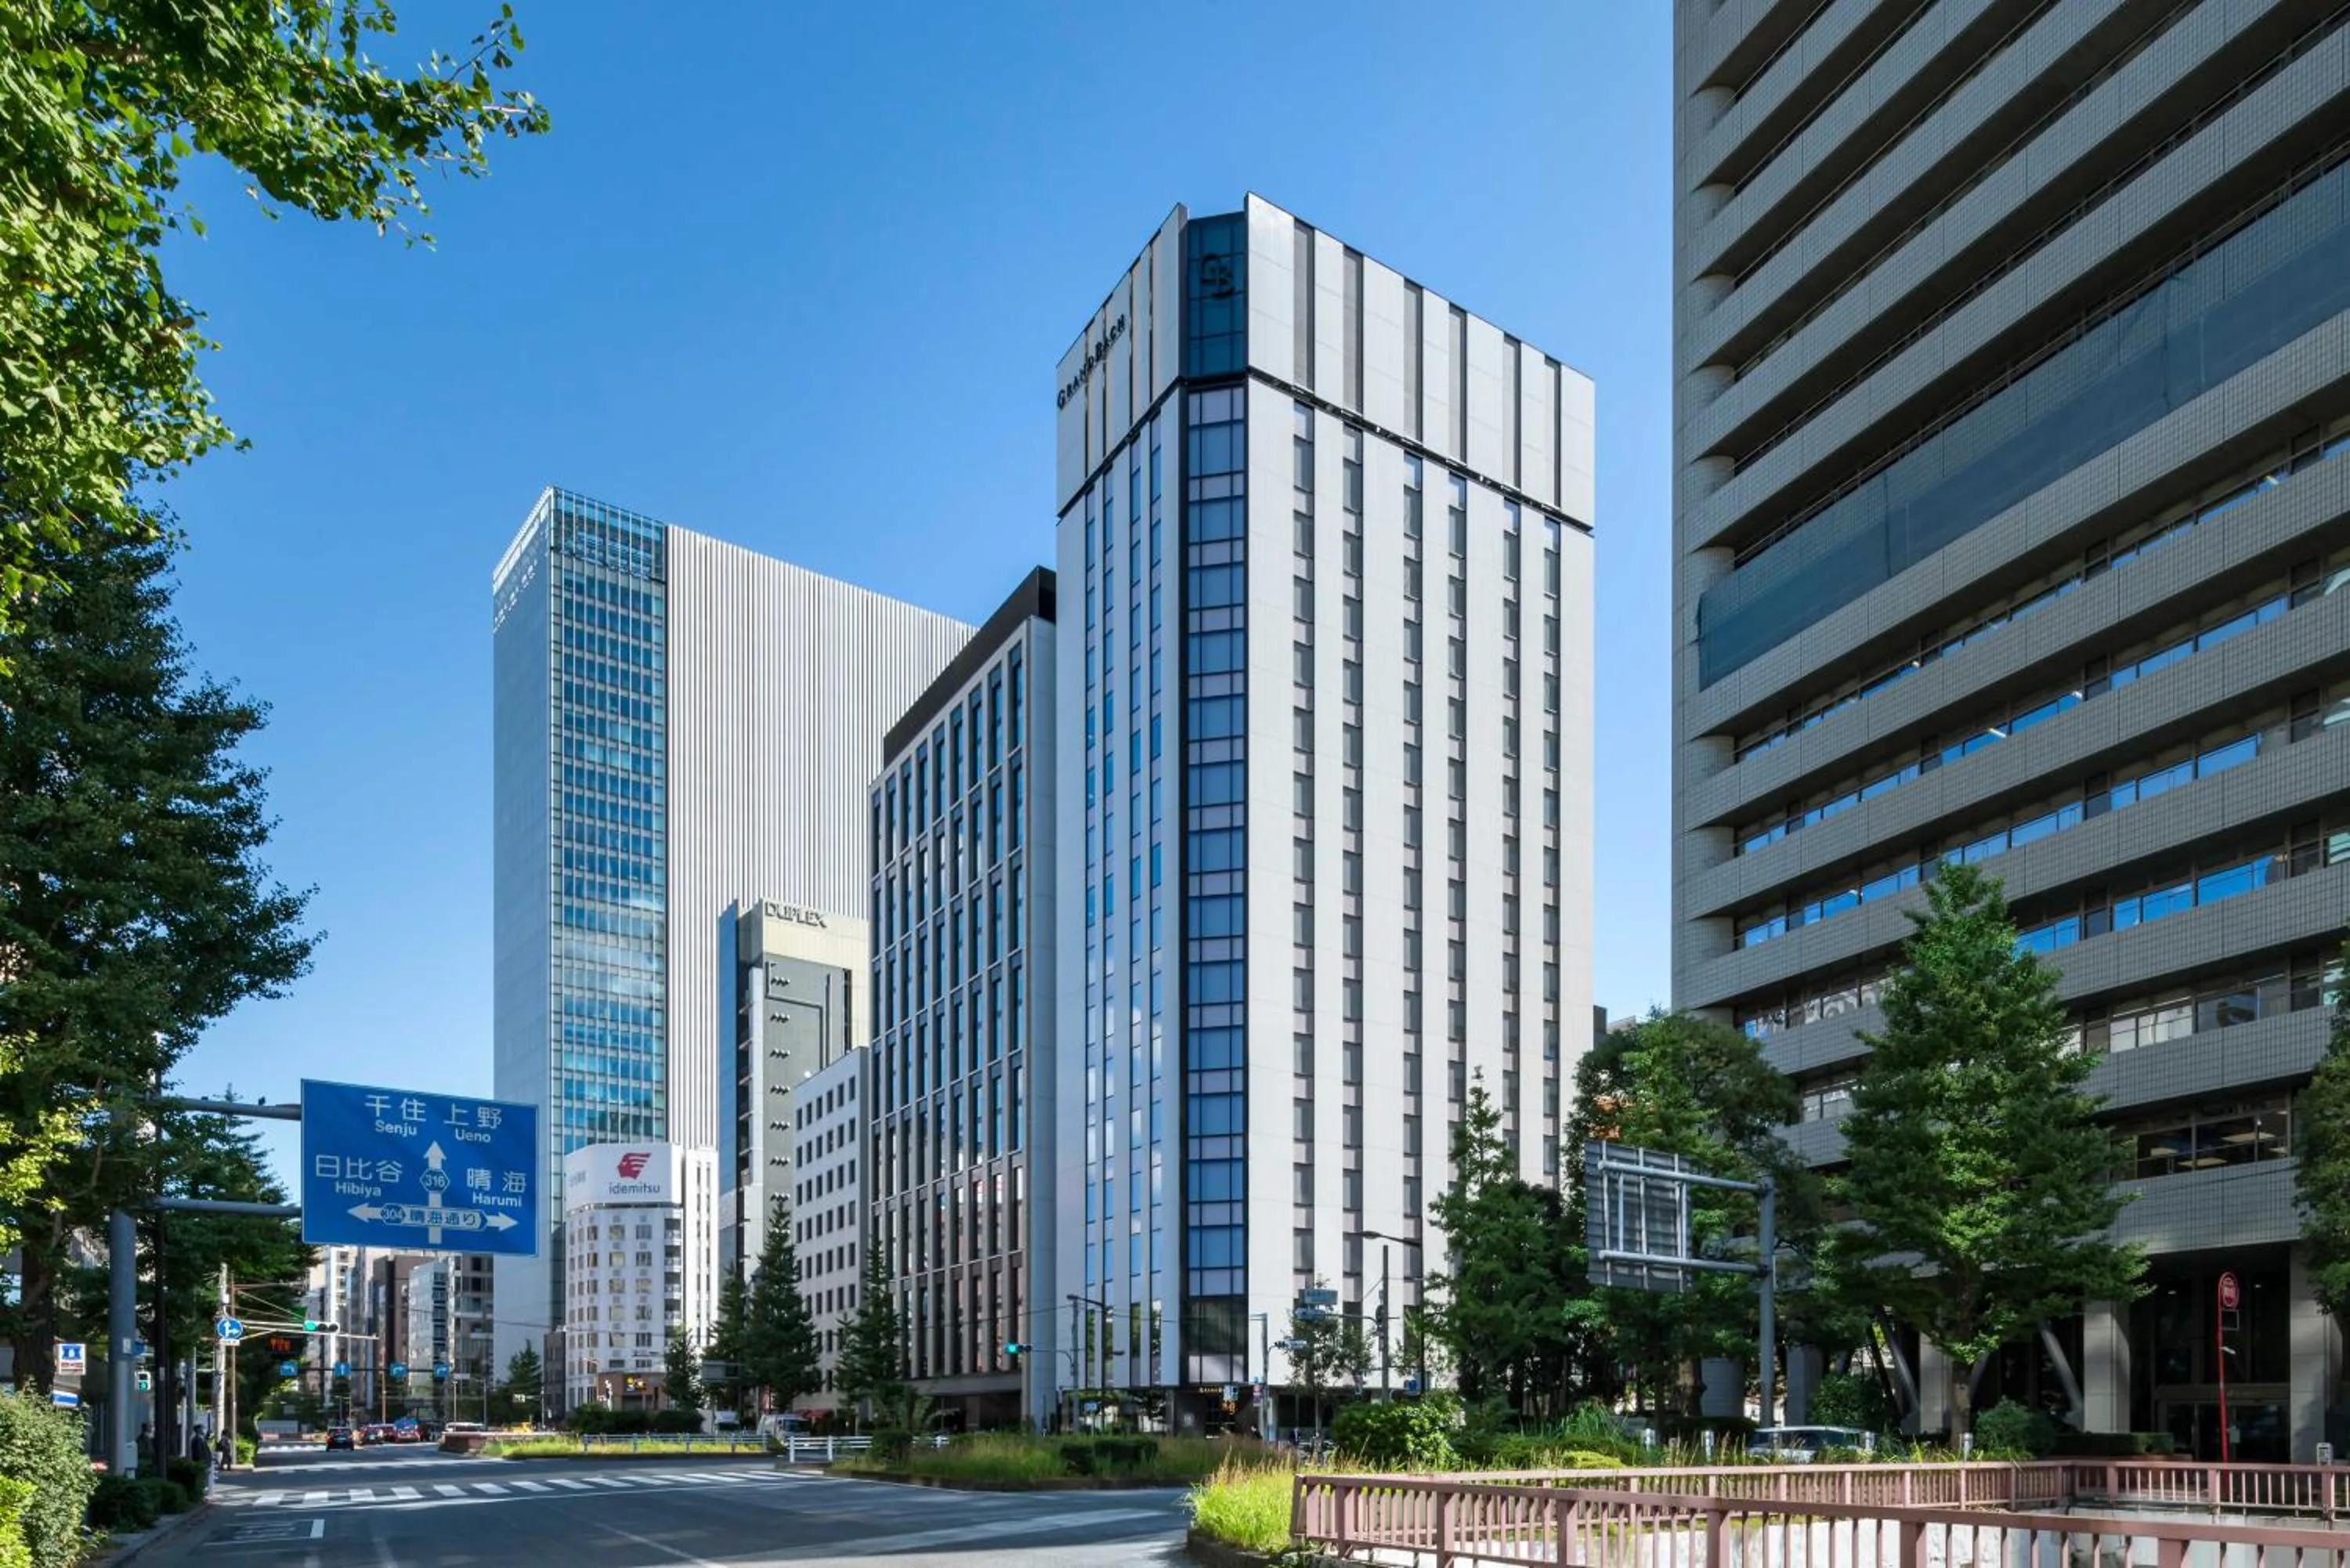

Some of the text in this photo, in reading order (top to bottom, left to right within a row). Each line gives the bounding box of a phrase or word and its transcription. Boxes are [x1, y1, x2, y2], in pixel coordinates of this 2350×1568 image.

[765, 901, 827, 929] DUPLEX
[364, 1094, 427, 1122] 千住
[443, 1103, 502, 1129] 上野
[375, 1120, 418, 1136] Senju
[455, 1129, 491, 1143] Ueno
[316, 1154, 403, 1183] 日比谷
[335, 1182, 381, 1199] Hibiya
[466, 1168, 526, 1194] 晴海
[609, 1182, 660, 1194] idemitsu
[472, 1192, 522, 1208] Harumi
